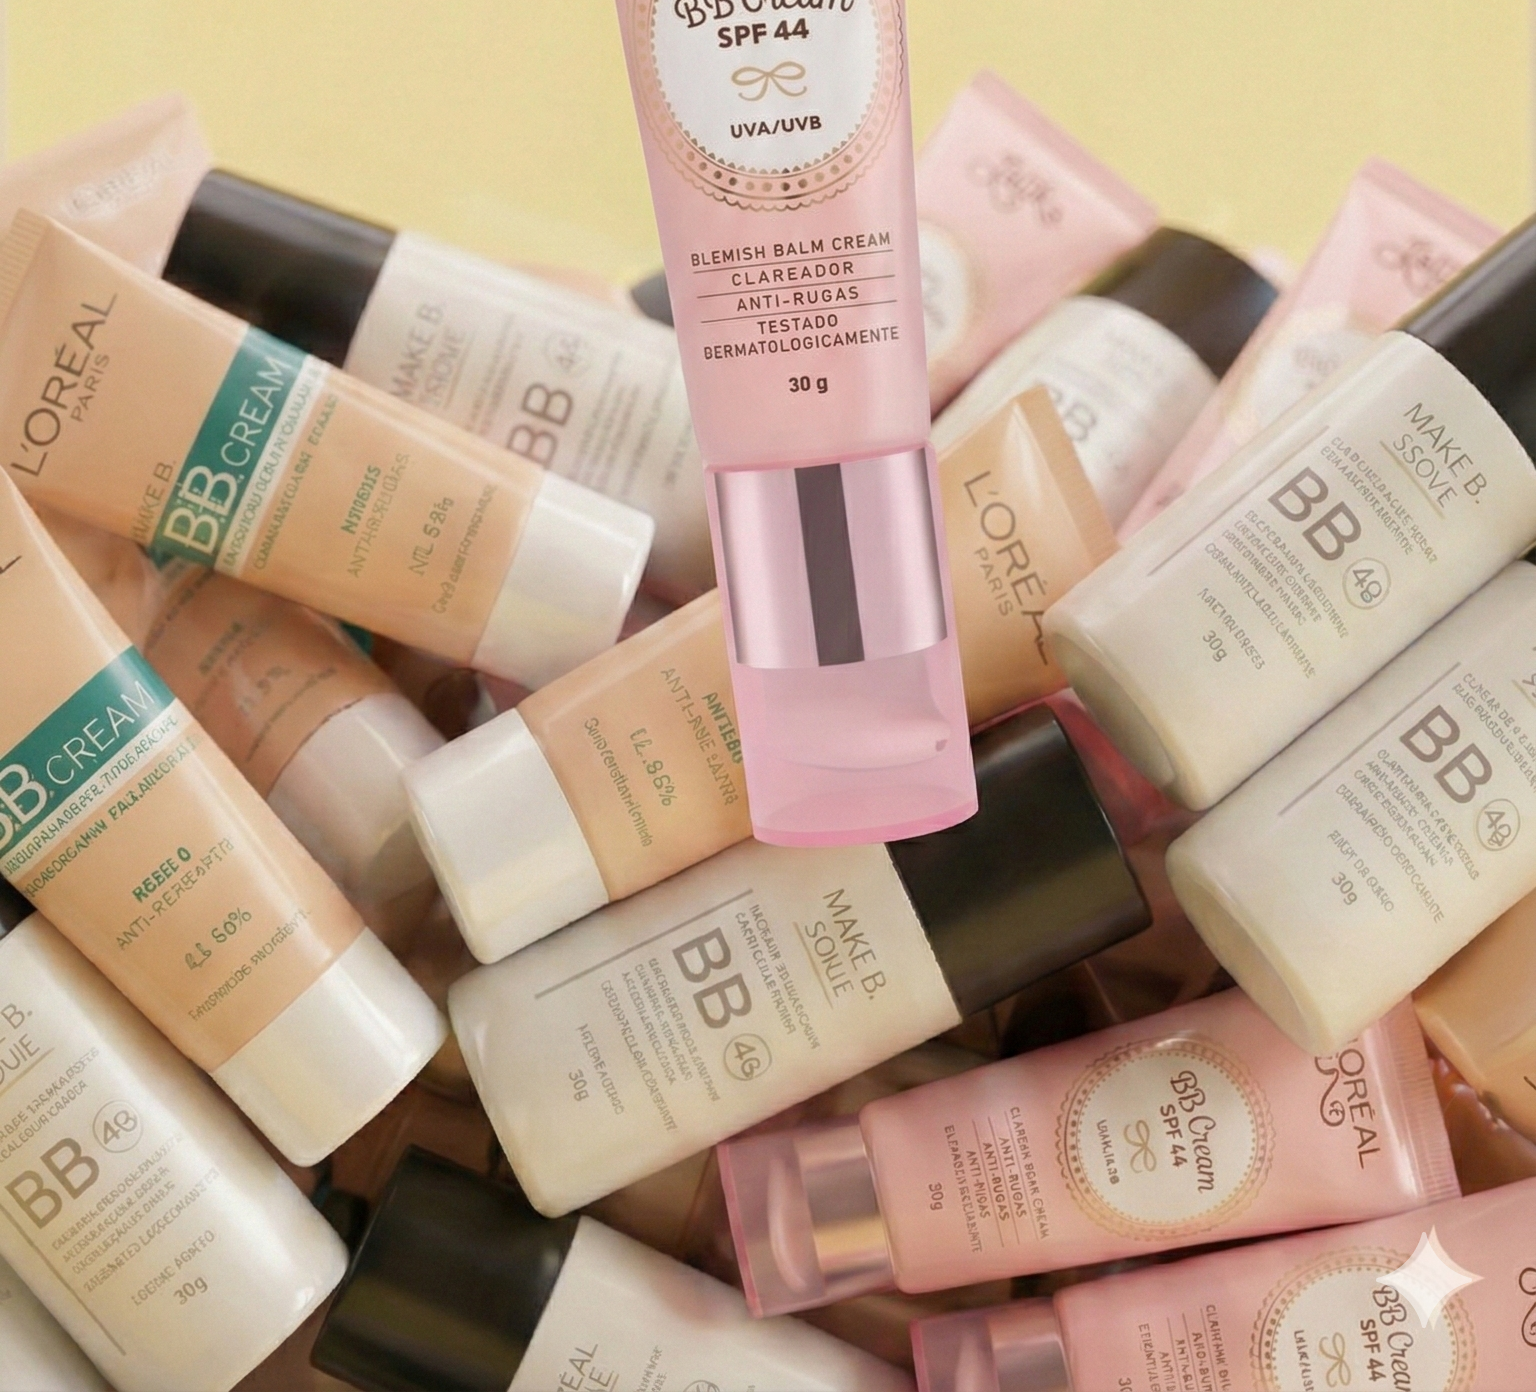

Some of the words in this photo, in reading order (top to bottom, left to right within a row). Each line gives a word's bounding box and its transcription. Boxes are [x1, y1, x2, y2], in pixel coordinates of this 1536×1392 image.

[717, 23, 767, 48] SPF
[774, 18, 809, 40] 44
[730, 116, 822, 139] UVA/UVB
[691, 245, 766, 267] BLEMISH
[773, 239, 824, 258] BALM
[832, 231, 891, 251] CREAM
[731, 261, 855, 287] CLAREADOR
[736, 286, 860, 312] ANTI-RUGAS
[757, 314, 838, 335] TESTADO
[10, 292, 118, 477] L'ORÉAL
[70, 353, 110, 423] PARIS
[788, 376, 811, 393] 30
[816, 377, 828, 394] g
[220, 357, 292, 467] CREAM
[505, 382, 574, 469] BB
[1402, 402, 1474, 479] MAKE
[1462, 471, 1489, 505] B.
[1267, 465, 1363, 562] BB
[974, 547, 1014, 618] PARIS
[1201, 629, 1228, 664] 30g
[46, 678, 156, 785] CREAM
[1399, 704, 1494, 805] BB
[1331, 870, 1359, 906] 30g
[823, 888, 877, 971] MAKE
[860, 970, 887, 1000] B.
[671, 926, 753, 1030] BB
[1, 1003, 33, 1029] B.
[1160, 1104, 1183, 1139] SPF
[1170, 1070, 1206, 1113] BB
[1188, 1115, 1216, 1194] Cream
[1170, 1144, 1188, 1169] 44
[4, 1137, 100, 1229] BB
[172, 1275, 208, 1305] 30g
[1360, 1319, 1381, 1353] SPF
[1368, 1358, 1387, 1382] 44
